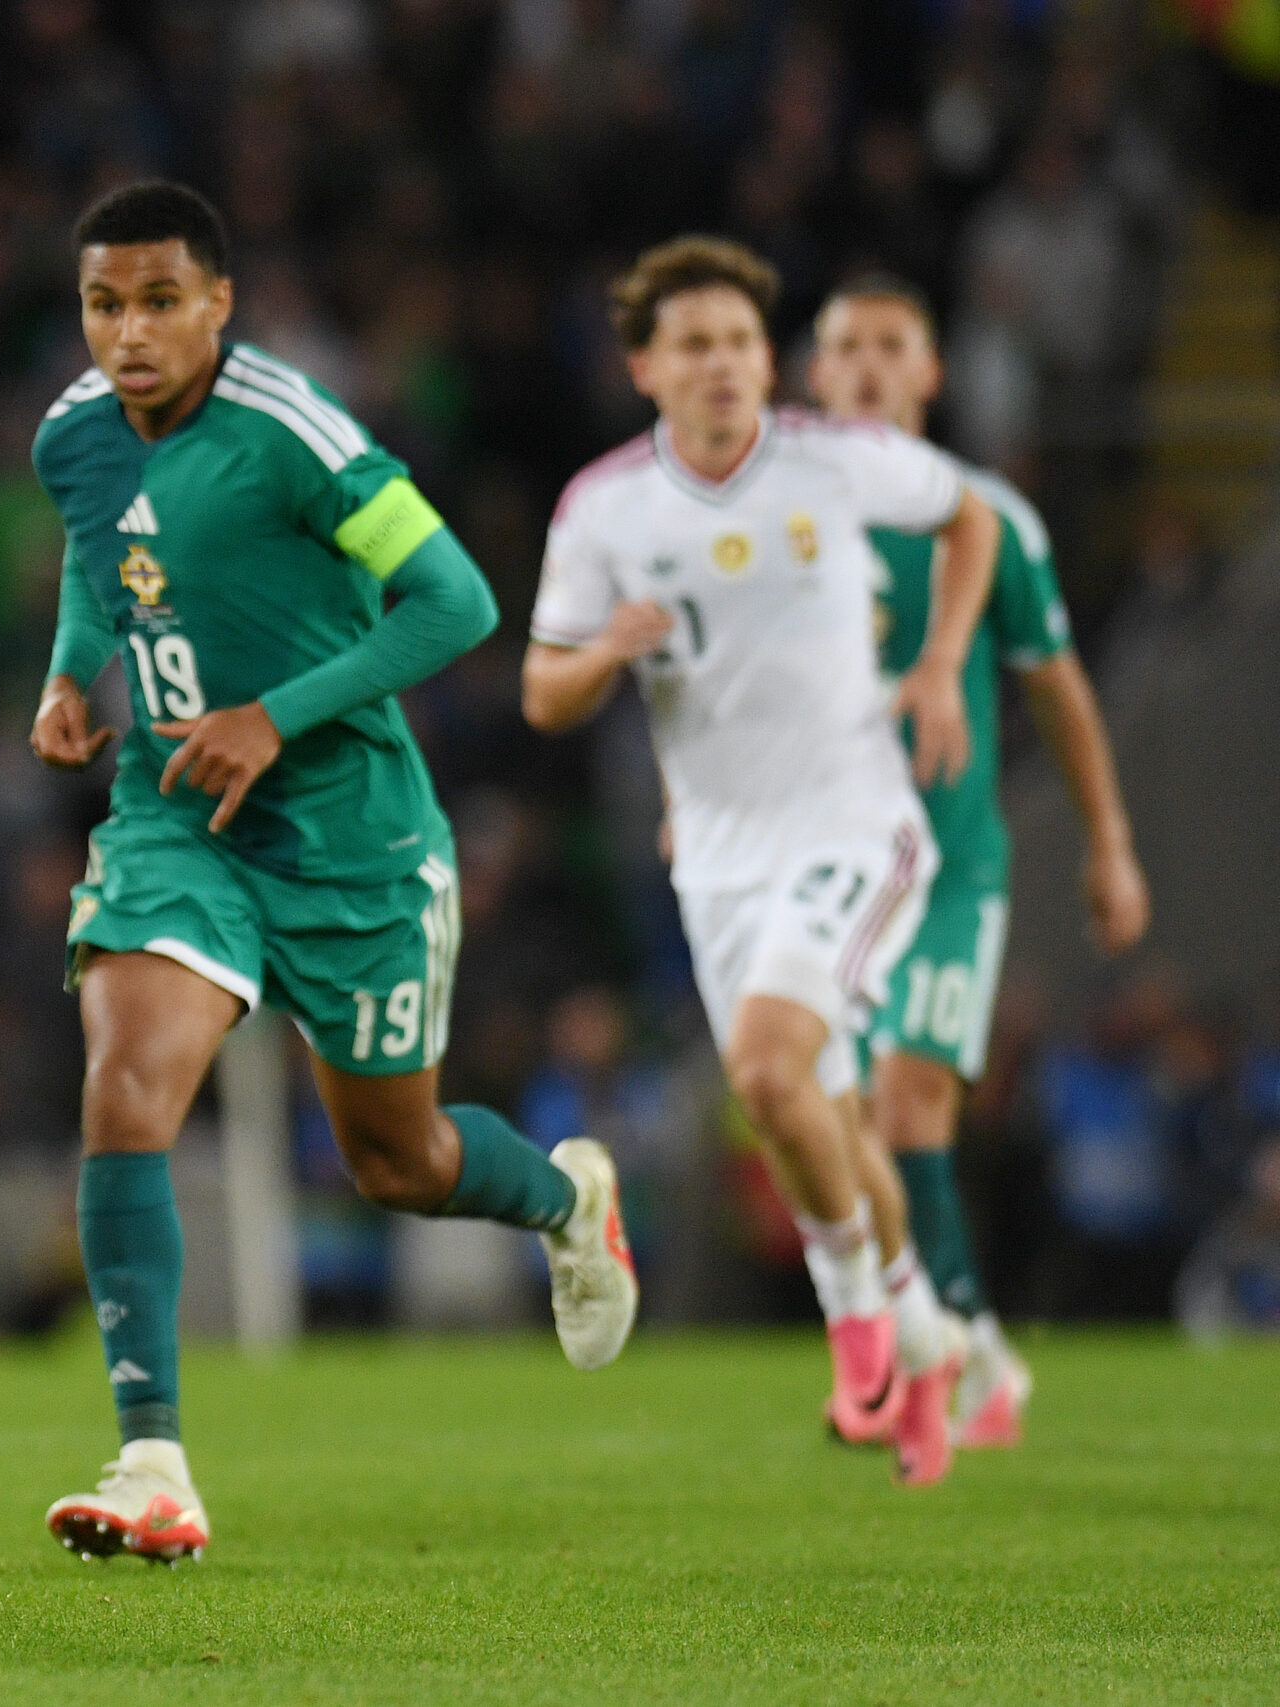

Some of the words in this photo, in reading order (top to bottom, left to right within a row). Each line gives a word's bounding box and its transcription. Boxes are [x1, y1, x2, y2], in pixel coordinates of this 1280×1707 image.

[361, 503, 411, 553] RESPECT
[128, 632, 205, 720] 19
[351, 980, 422, 1060] 19
[904, 957, 976, 1043] 10
